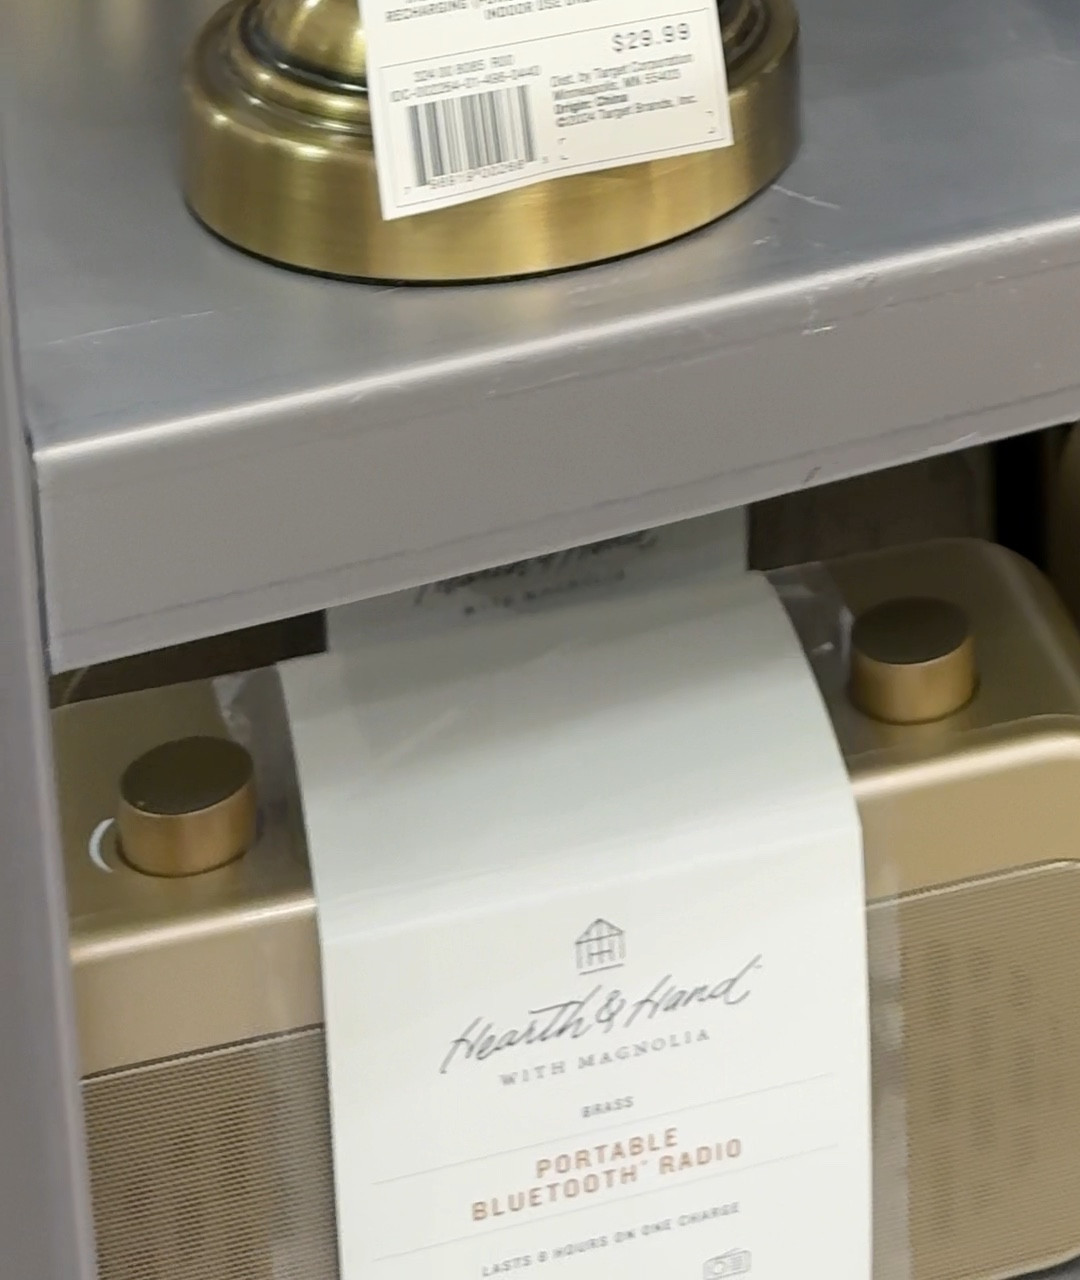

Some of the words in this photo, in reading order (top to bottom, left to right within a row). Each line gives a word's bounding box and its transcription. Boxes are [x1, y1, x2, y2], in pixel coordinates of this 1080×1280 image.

[484, 2, 533, 21] INDOOR
[612, 22, 691, 53] $29.99
[439, 983, 603, 1075] Hearth
[595, 989, 627, 1035] &
[498, 1059, 567, 1087] WITH
[577, 1028, 711, 1071] MAGNOLIA
[581, 1095, 635, 1119] BRASS
[536, 1127, 678, 1180] PORTABLE
[658, 1137, 743, 1176] RADIO
[481, 1253, 533, 1278] LASTS
[536, 1249, 549, 1263] 8
[553, 1235, 609, 1259] HOURS
[614, 1228, 637, 1244] ON
[640, 1218, 673, 1237] ONE
[677, 1201, 741, 1227] CHARGE
